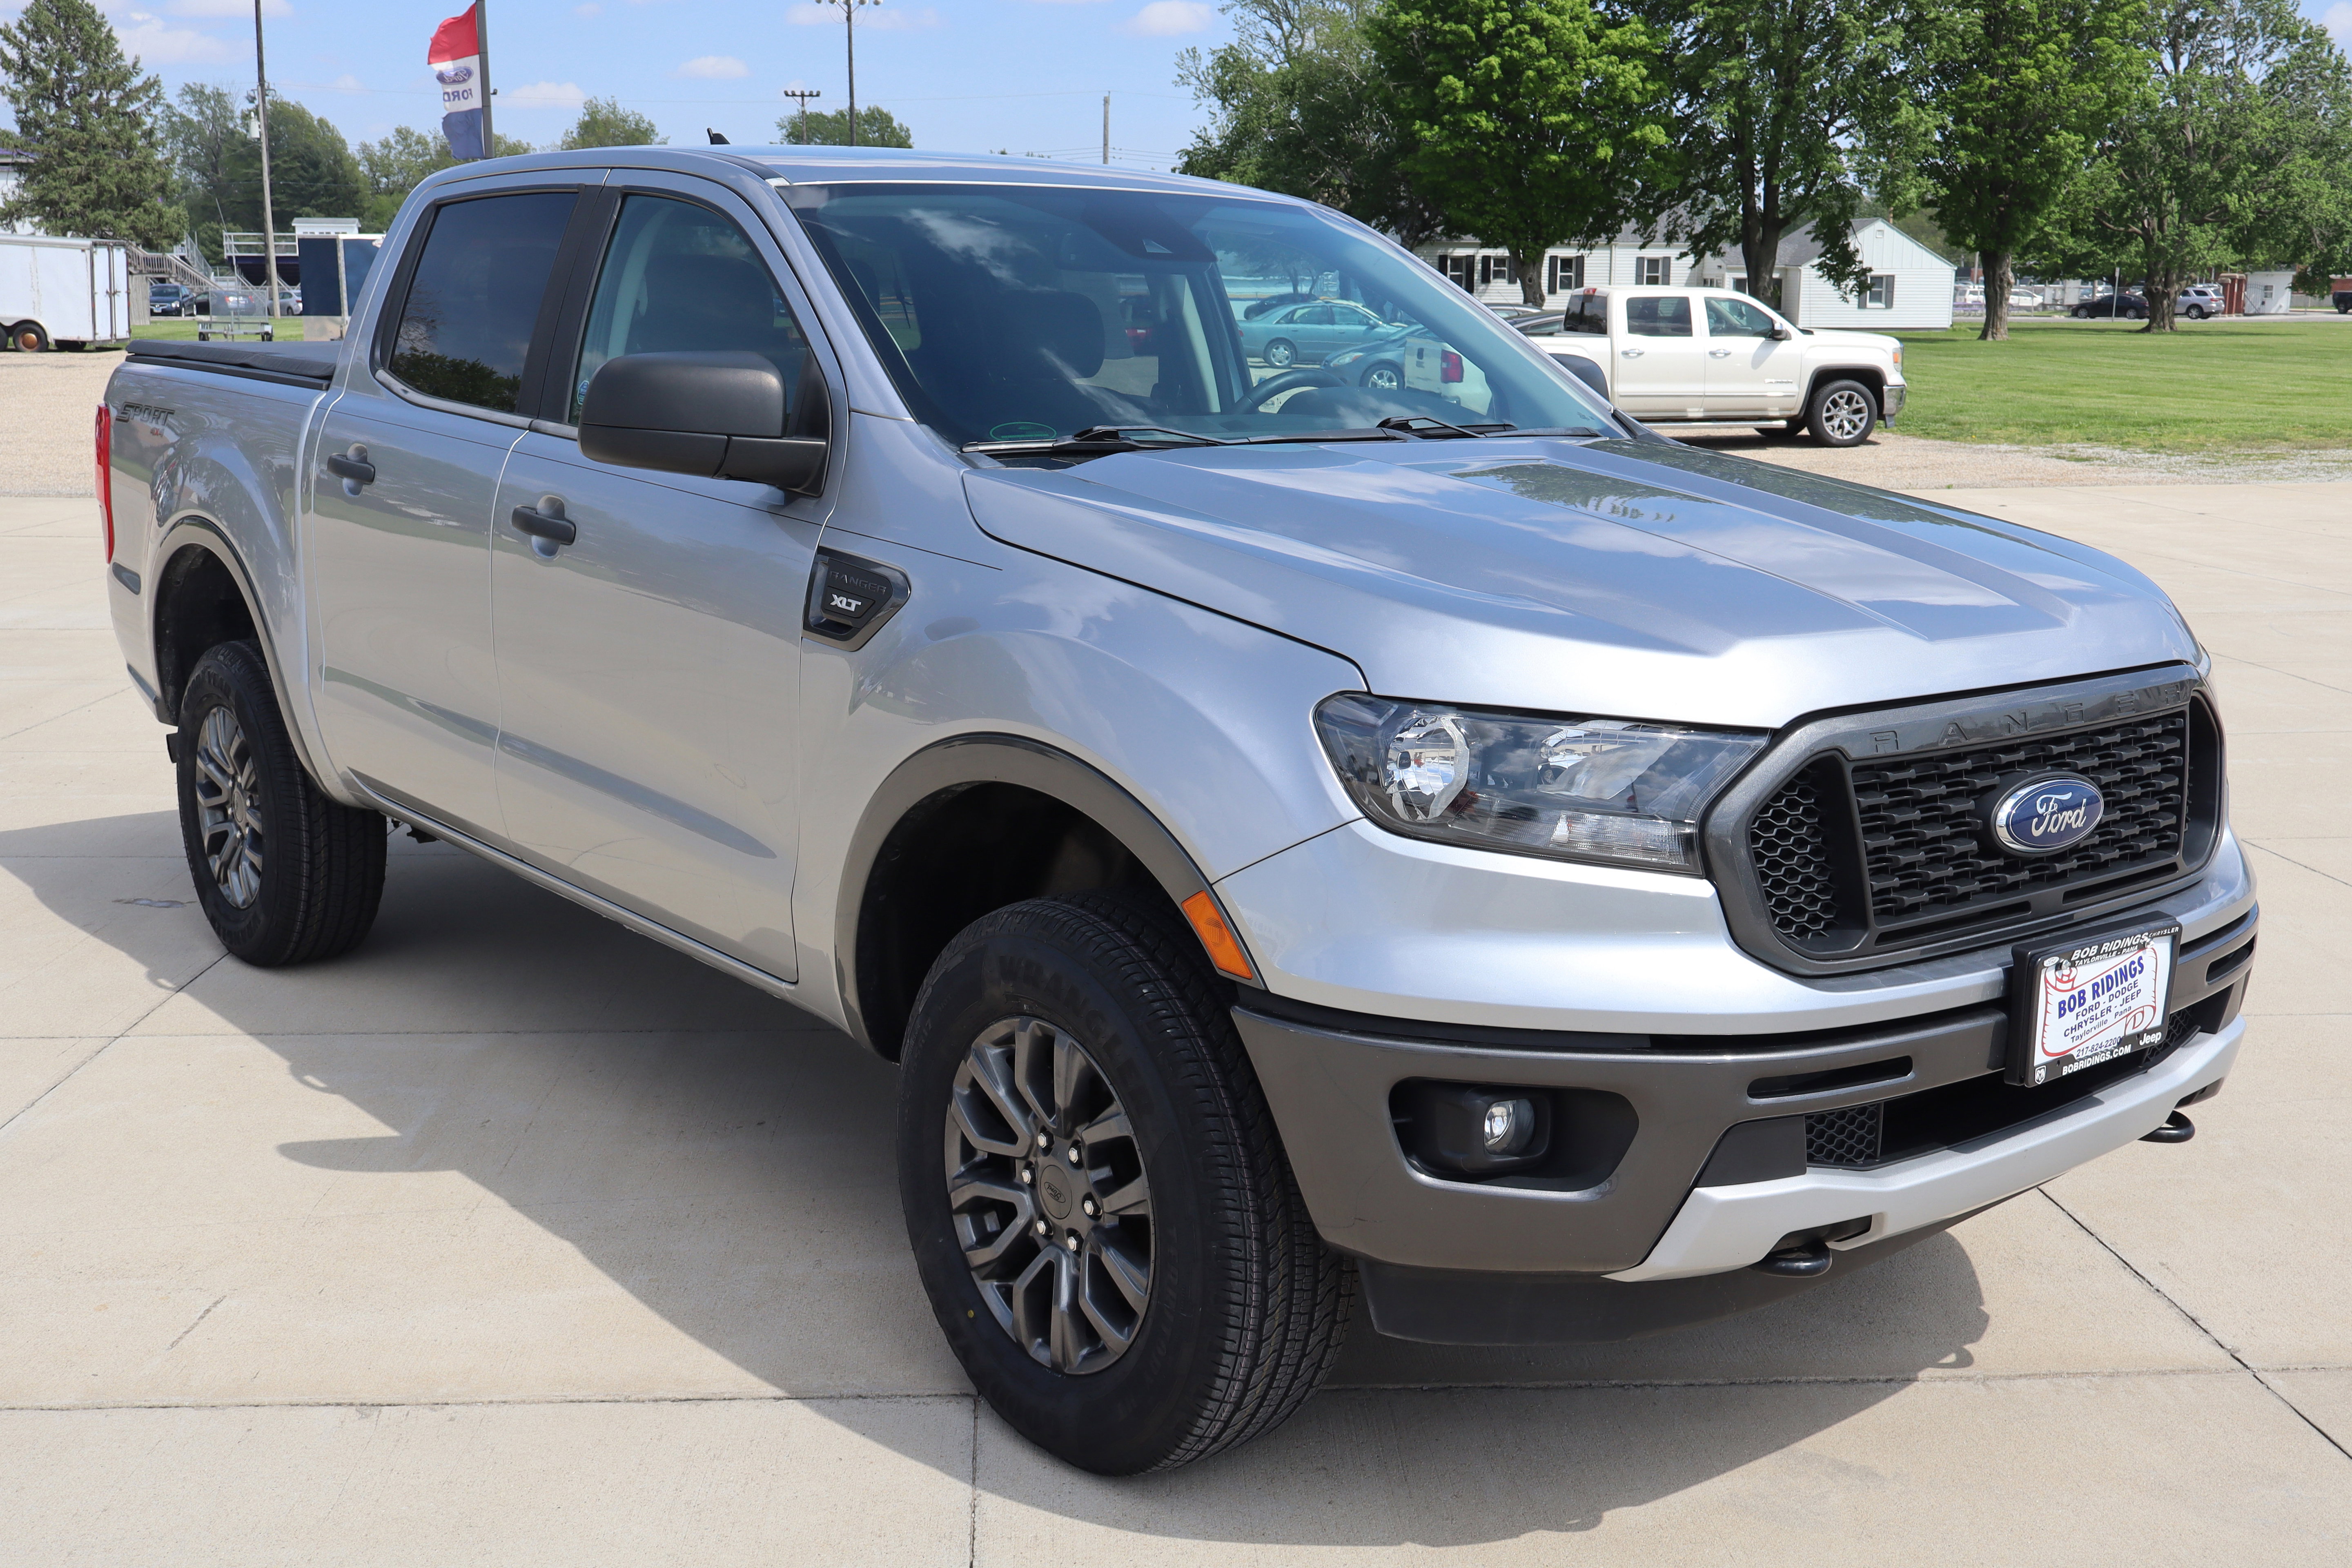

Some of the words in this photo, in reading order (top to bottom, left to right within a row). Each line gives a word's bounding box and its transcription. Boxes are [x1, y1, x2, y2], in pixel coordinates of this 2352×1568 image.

[115, 401, 175, 426] SPORT
[830, 570, 887, 595] RANGER
[829, 593, 862, 612] XLT
[1869, 685, 2181, 753] RANGER
[2031, 791, 2087, 837] Ford
[2149, 927, 2179, 938] CHRYSLER
[2071, 945, 2098, 961] BOB
[2100, 932, 2149, 954] RIDINGS
[2074, 950, 2116, 967] TAYLORVILLE
[2121, 945, 2138, 955] PANA
[2058, 989, 2087, 1020] BOB
[2091, 956, 2144, 1001] RIDINGS
[2076, 1001, 2100, 1021] FORD
[2109, 979, 2138, 1003] DODGE
[2064, 1005, 2112, 1037] CHRYSLER
[2119, 989, 2142, 1007] JEEP
[2071, 1019, 2108, 1043] Taylorville
[2114, 1006, 2132, 1019] Pana
[2076, 1036, 2121, 1058] 217-824-2200
[2139, 1031, 2162, 1046] Jeep
[2062, 1044, 2132, 1076] BOBRIDINGS.COM
[1047, 1184, 1062, 1200] Ford
